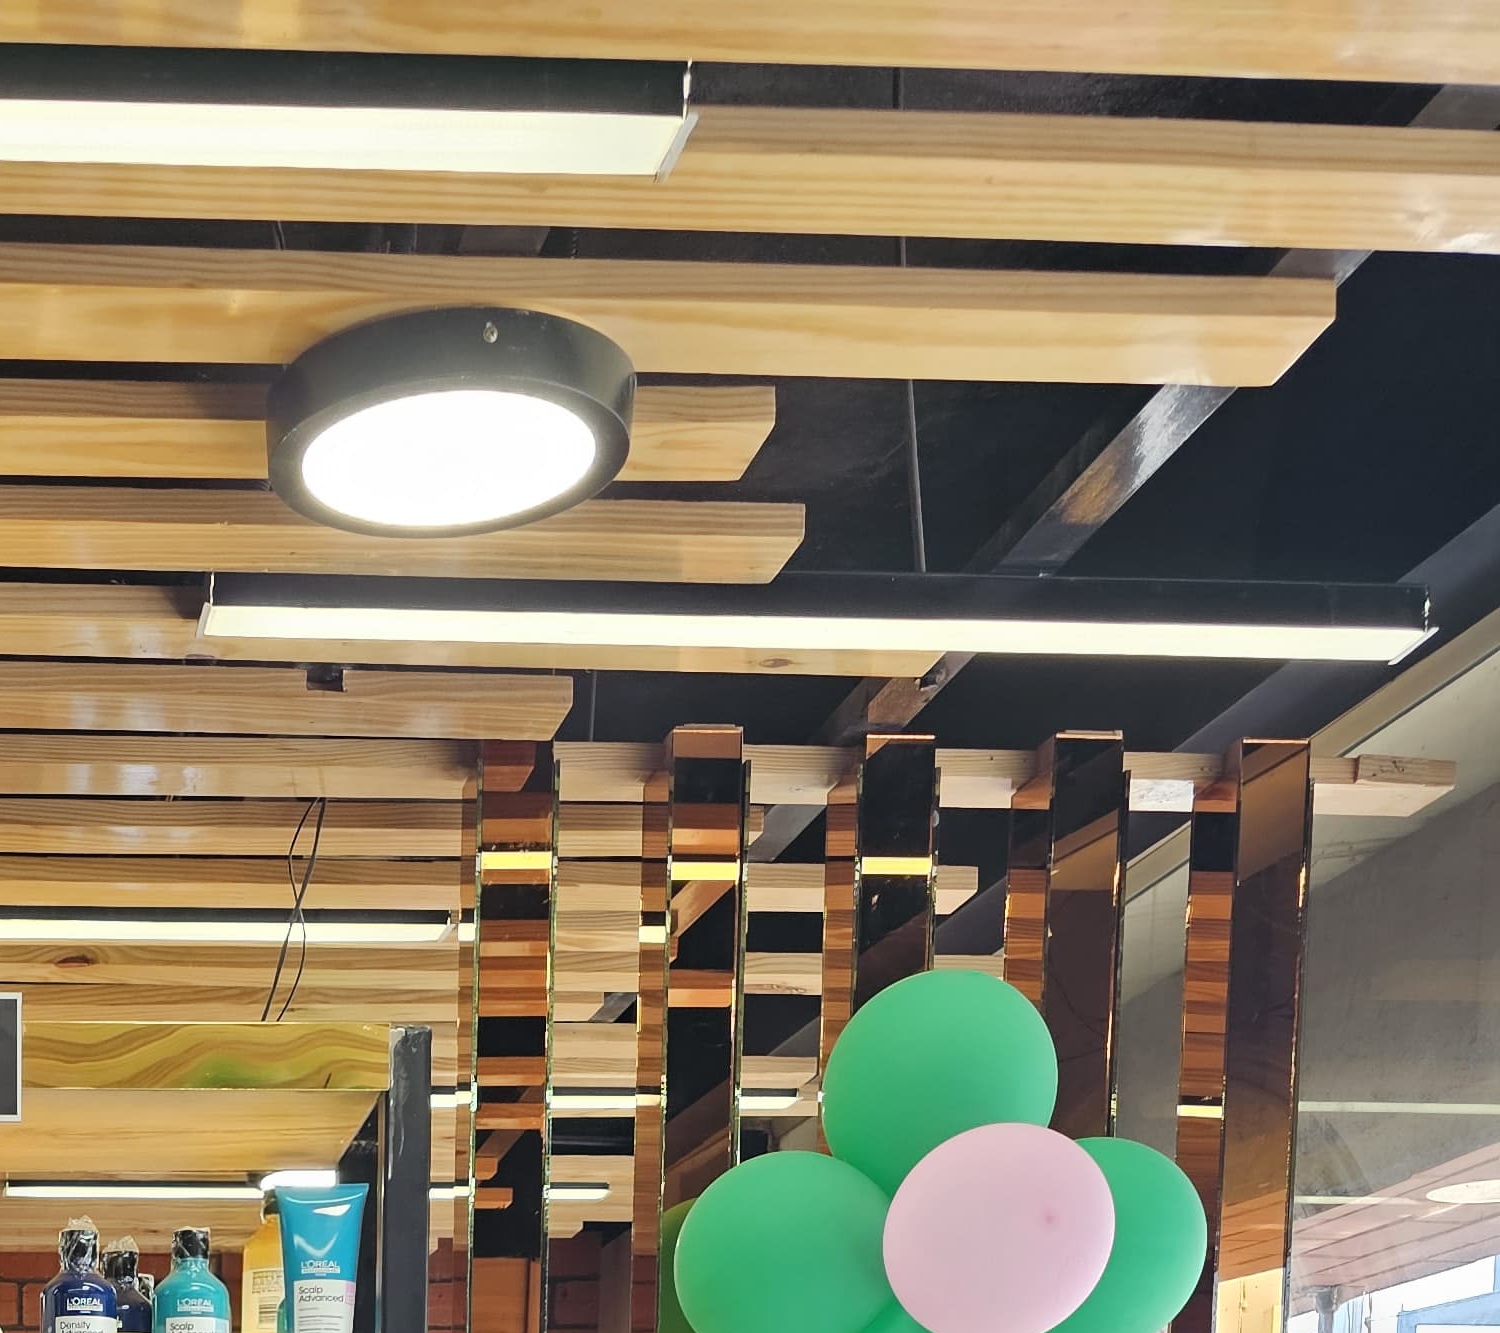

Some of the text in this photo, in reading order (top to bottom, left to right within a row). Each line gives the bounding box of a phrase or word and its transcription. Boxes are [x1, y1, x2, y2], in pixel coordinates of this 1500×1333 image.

[298, 1286, 323, 1295] Scalp
[298, 1295, 344, 1303] Advanced
[60, 1321, 91, 1330] Density
[170, 1322, 194, 1332] Scalp
